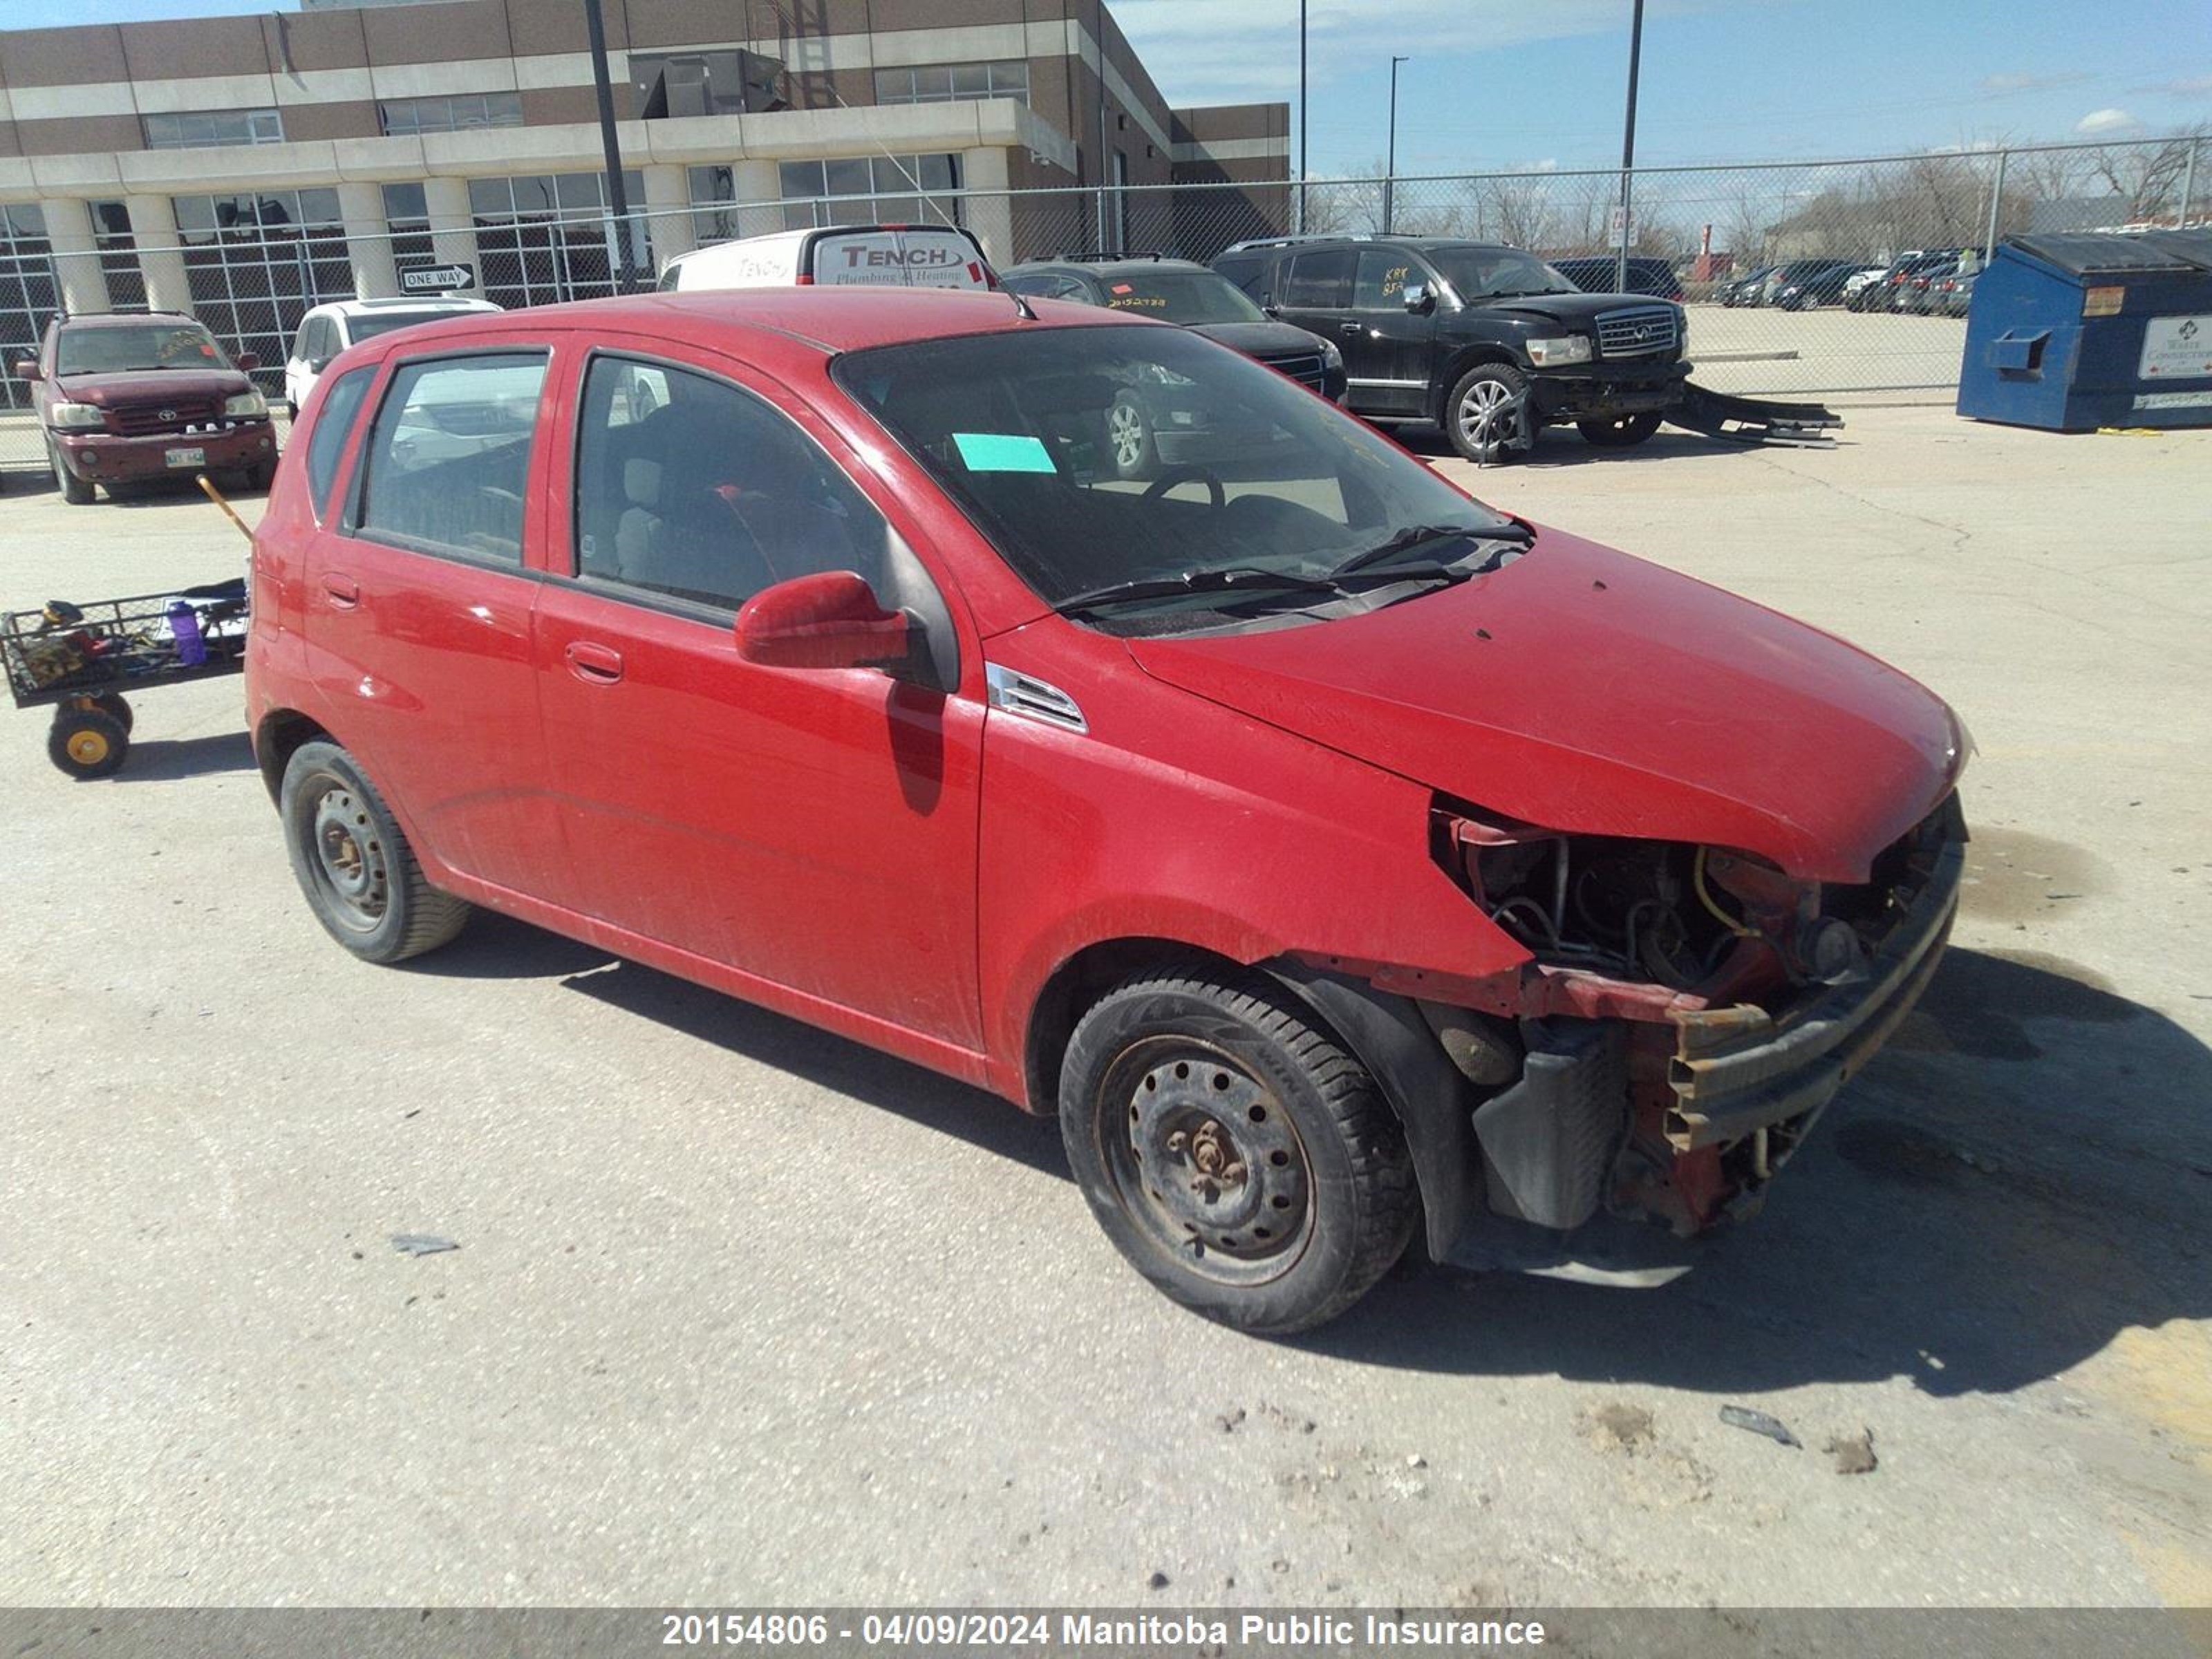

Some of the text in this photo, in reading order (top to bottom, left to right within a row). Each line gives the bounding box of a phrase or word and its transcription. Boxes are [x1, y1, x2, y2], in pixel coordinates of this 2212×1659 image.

[841, 246, 946, 267] TENCH
[408, 271, 461, 285] ONE WAY
[917, 270, 962, 281] Heating
